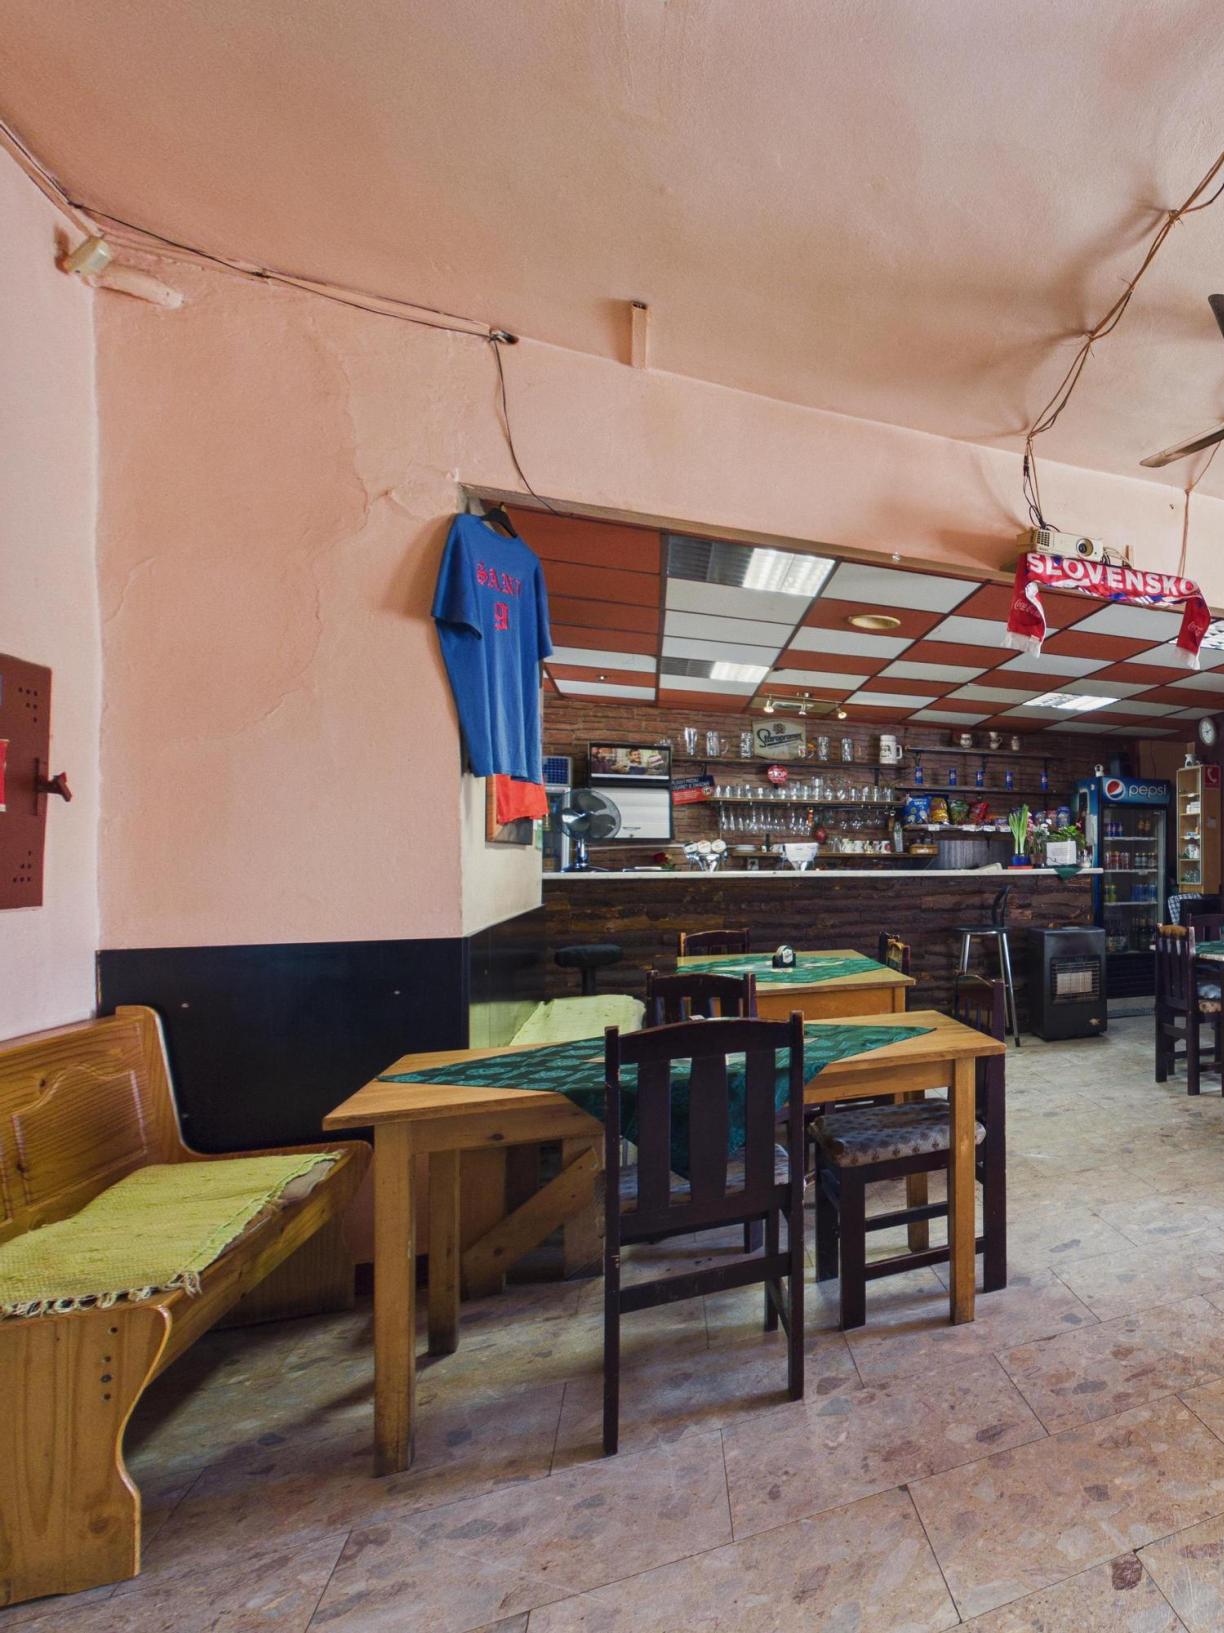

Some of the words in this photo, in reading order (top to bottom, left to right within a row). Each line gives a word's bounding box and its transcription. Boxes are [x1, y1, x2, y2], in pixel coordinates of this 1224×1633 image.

[1027, 553, 1198, 596] SLOVENSKO
[495, 602, 508, 630] 9
[1129, 785, 1166, 798] pepsi
